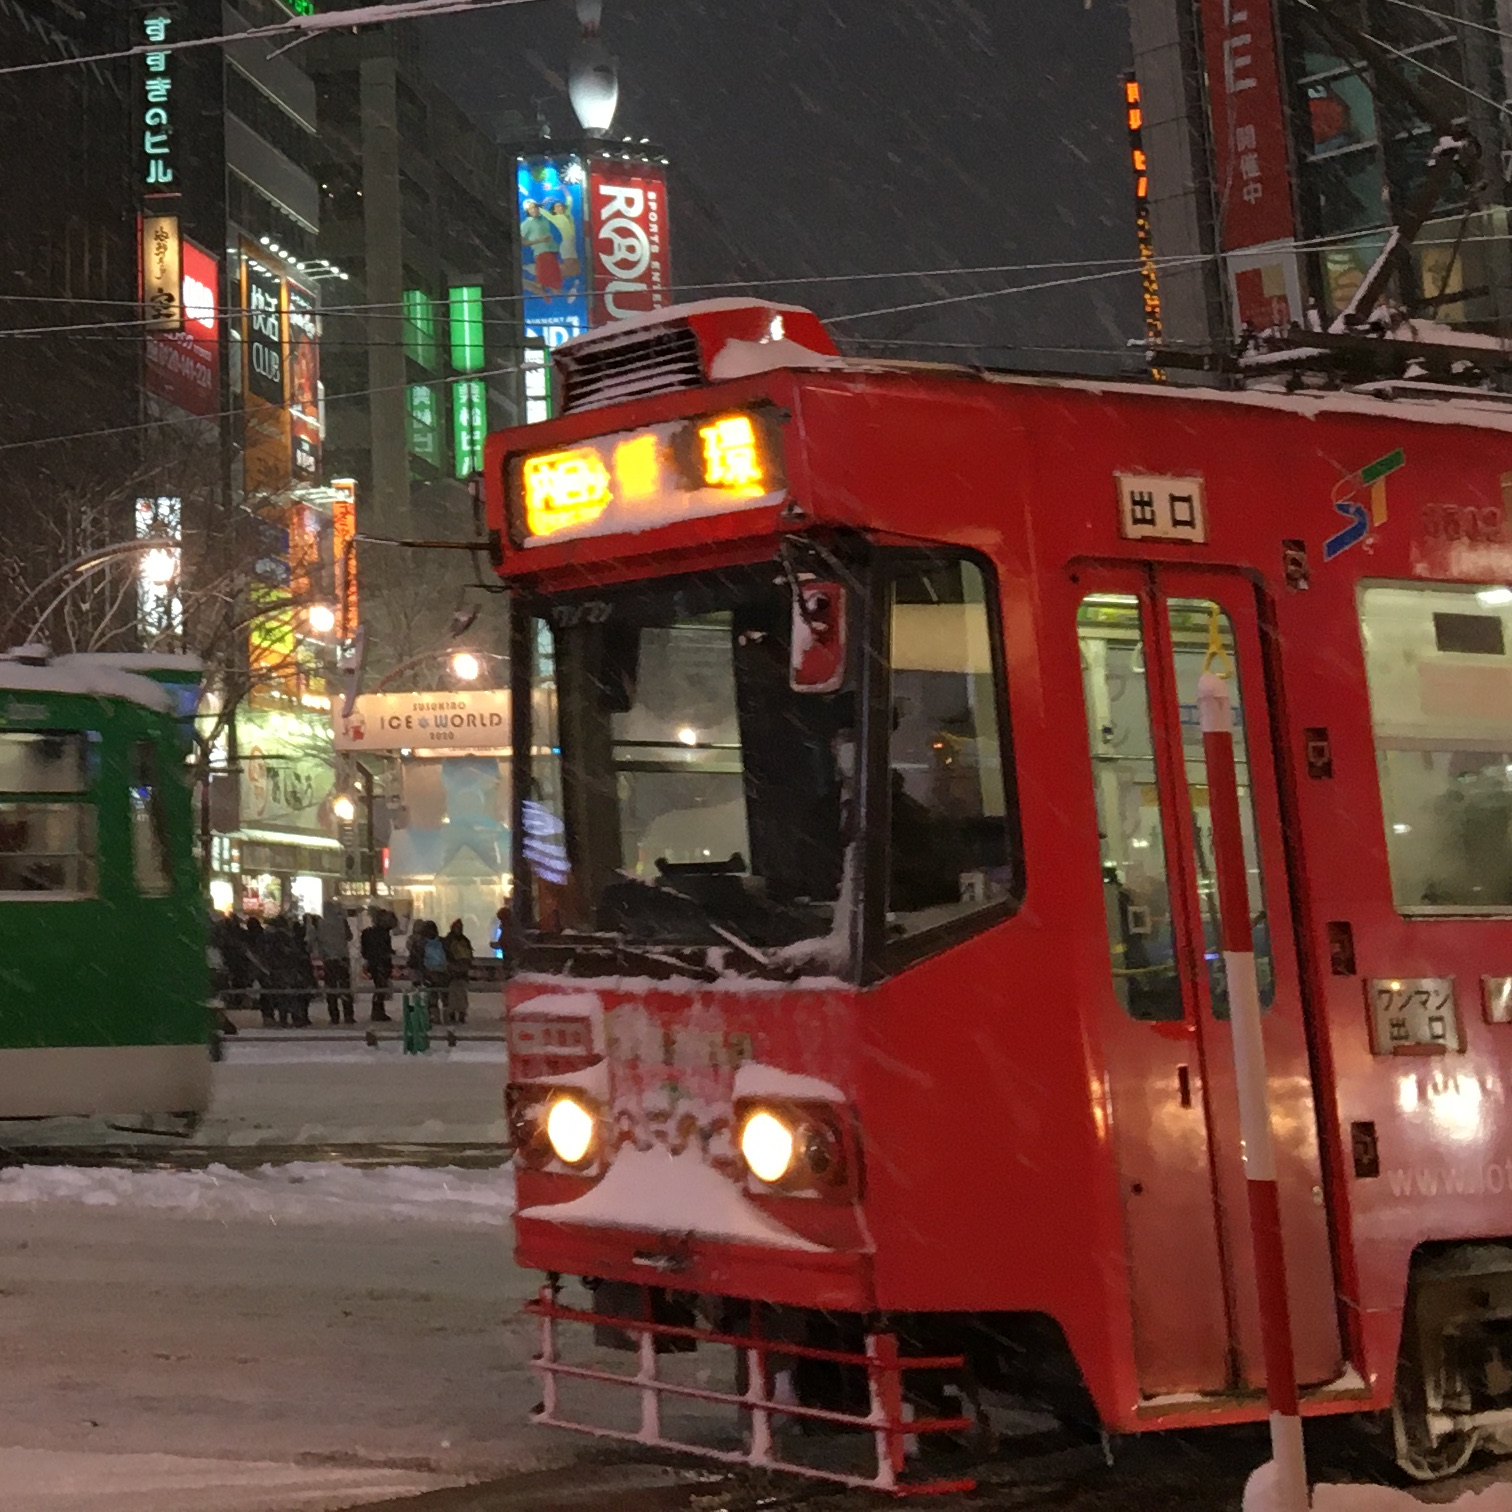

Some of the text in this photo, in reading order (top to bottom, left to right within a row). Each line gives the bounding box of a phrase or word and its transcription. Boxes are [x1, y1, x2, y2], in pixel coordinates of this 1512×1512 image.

[144, 15, 173, 184] すすきのビル
[647, 191, 660, 254] SPORTS
[252, 341, 281, 384] CLUB
[1130, 489, 1197, 530] 出口
[380, 712, 503, 730] ICE WORLD
[1389, 1015, 1447, 1040] 出口
